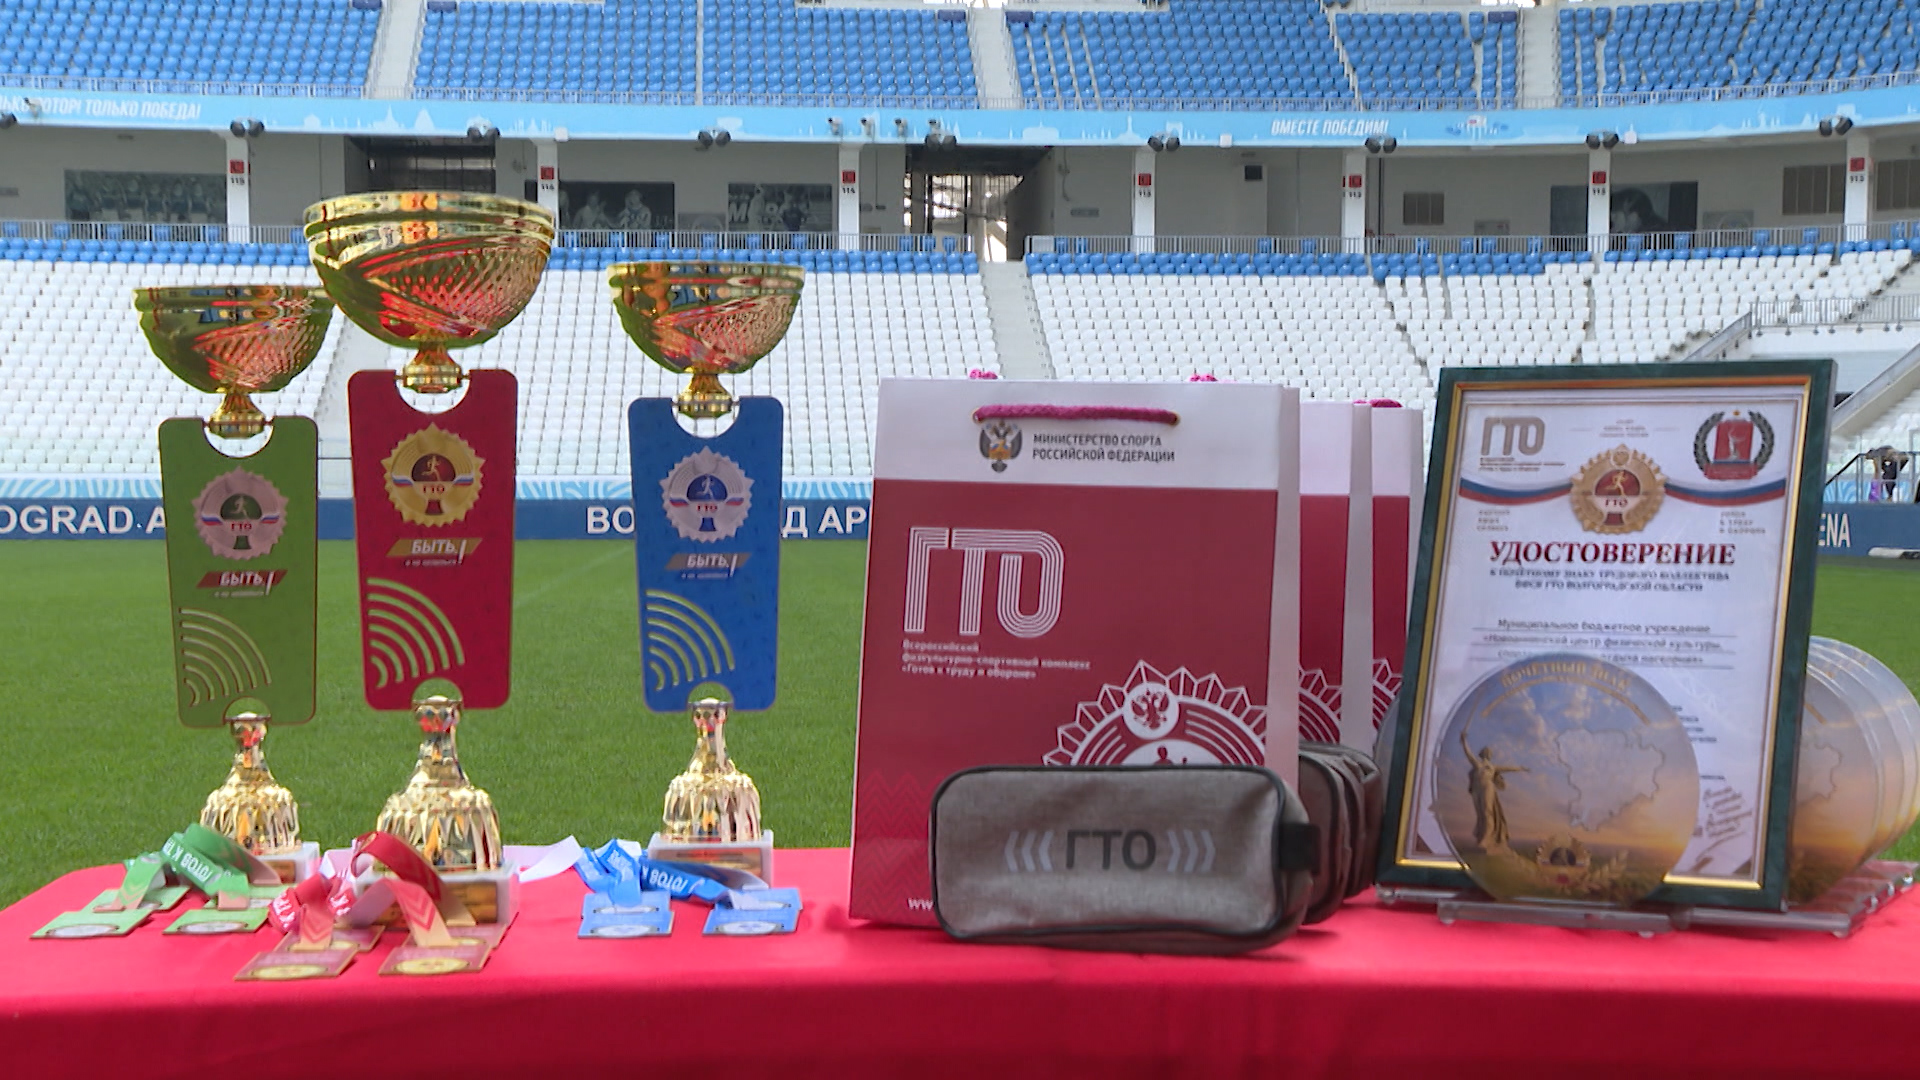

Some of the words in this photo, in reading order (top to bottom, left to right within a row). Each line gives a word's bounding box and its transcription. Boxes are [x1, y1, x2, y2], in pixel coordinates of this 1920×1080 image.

[33, 97, 81, 114] ОТОР!
[85, 99, 138, 117] ТОЛЬКО
[141, 102, 201, 120] ПОБЕДА!
[1271, 119, 1320, 136] ВМЕСТЕ
[1322, 119, 1390, 136] ПОБЕДИМ!
[1033, 433, 1119, 447] МИНИСТЕРСТВО
[1121, 435, 1162, 447] СПОРТА
[1481, 416, 1546, 456] ГТО
[1032, 446, 1105, 462] РОССИЙСКОЙ
[1107, 451, 1176, 464] ФЕДЕРАЦИИ
[0, 505, 107, 535] OGRAD
[1490, 541, 1737, 567] УДОСТОВЕРЕНИЕ
[904, 526, 1065, 638] ГТО
[1065, 829, 1158, 871] ГТО
[180, 851, 214, 883] ГОТОВ
[648, 868, 689, 893] ГОТОВ
